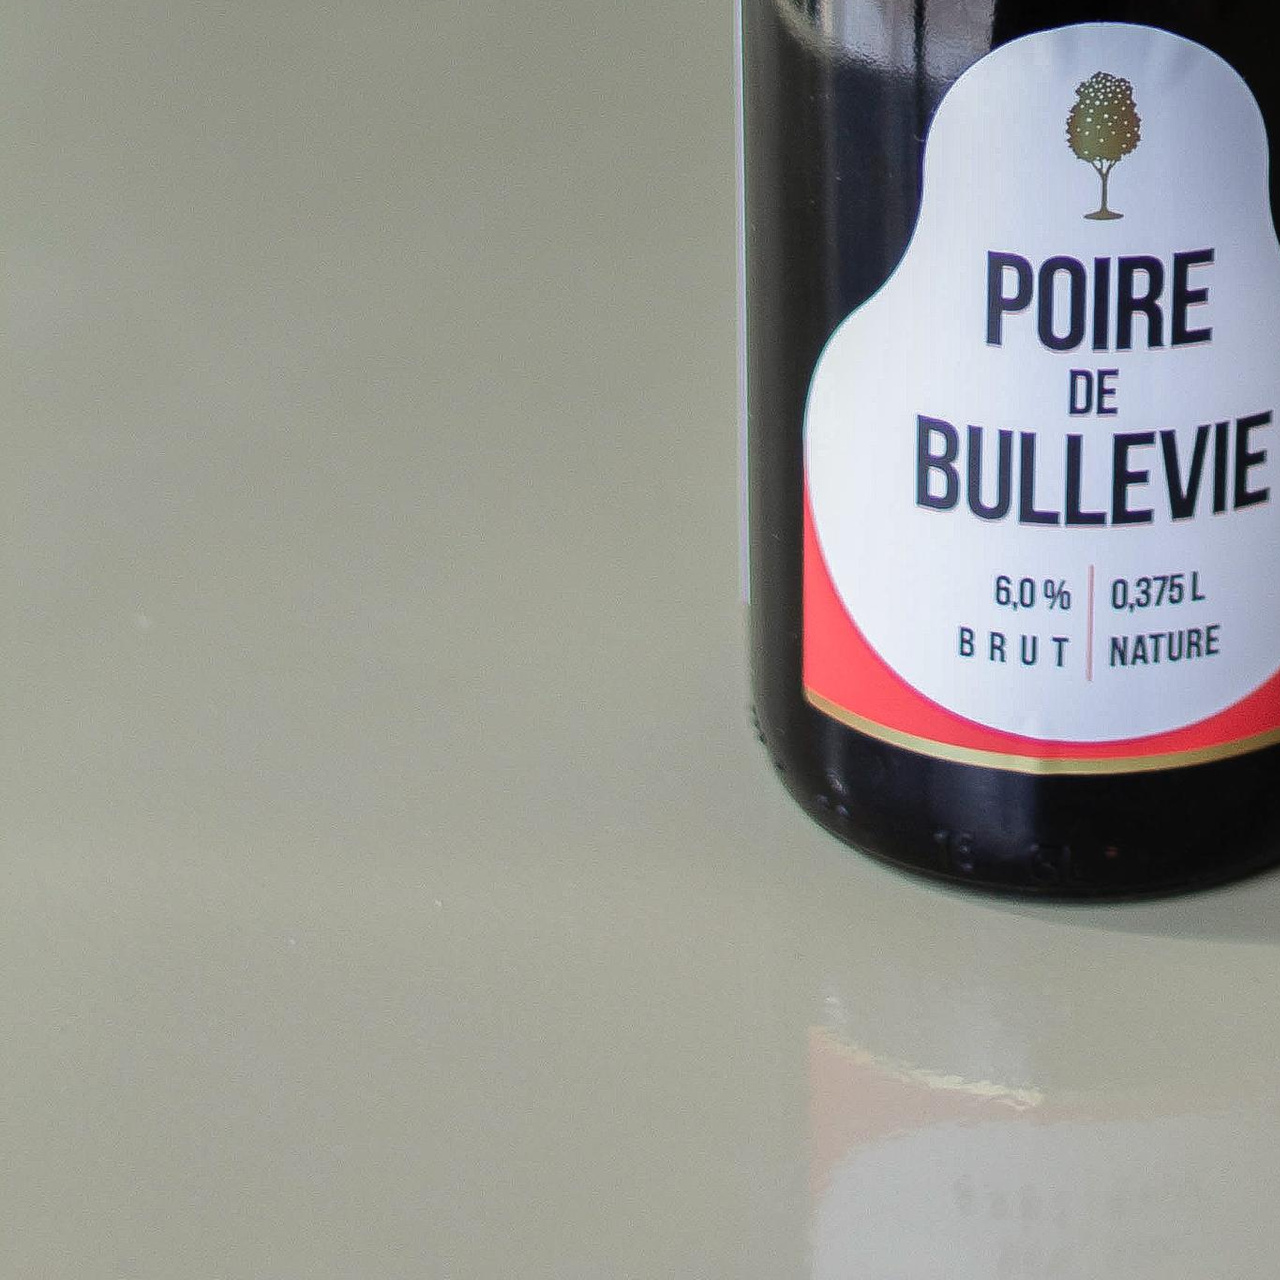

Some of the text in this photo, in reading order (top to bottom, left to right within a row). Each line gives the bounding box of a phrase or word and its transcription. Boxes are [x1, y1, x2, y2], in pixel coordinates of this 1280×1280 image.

[986, 248, 1216, 352] POIRE
[1068, 368, 1120, 416] DE
[916, 410, 1274, 528] BULLEVIE
[1111, 572, 1185, 613] 0,375
[1190, 570, 1207, 602] L
[959, 624, 1221, 668] BRUT NATURE
